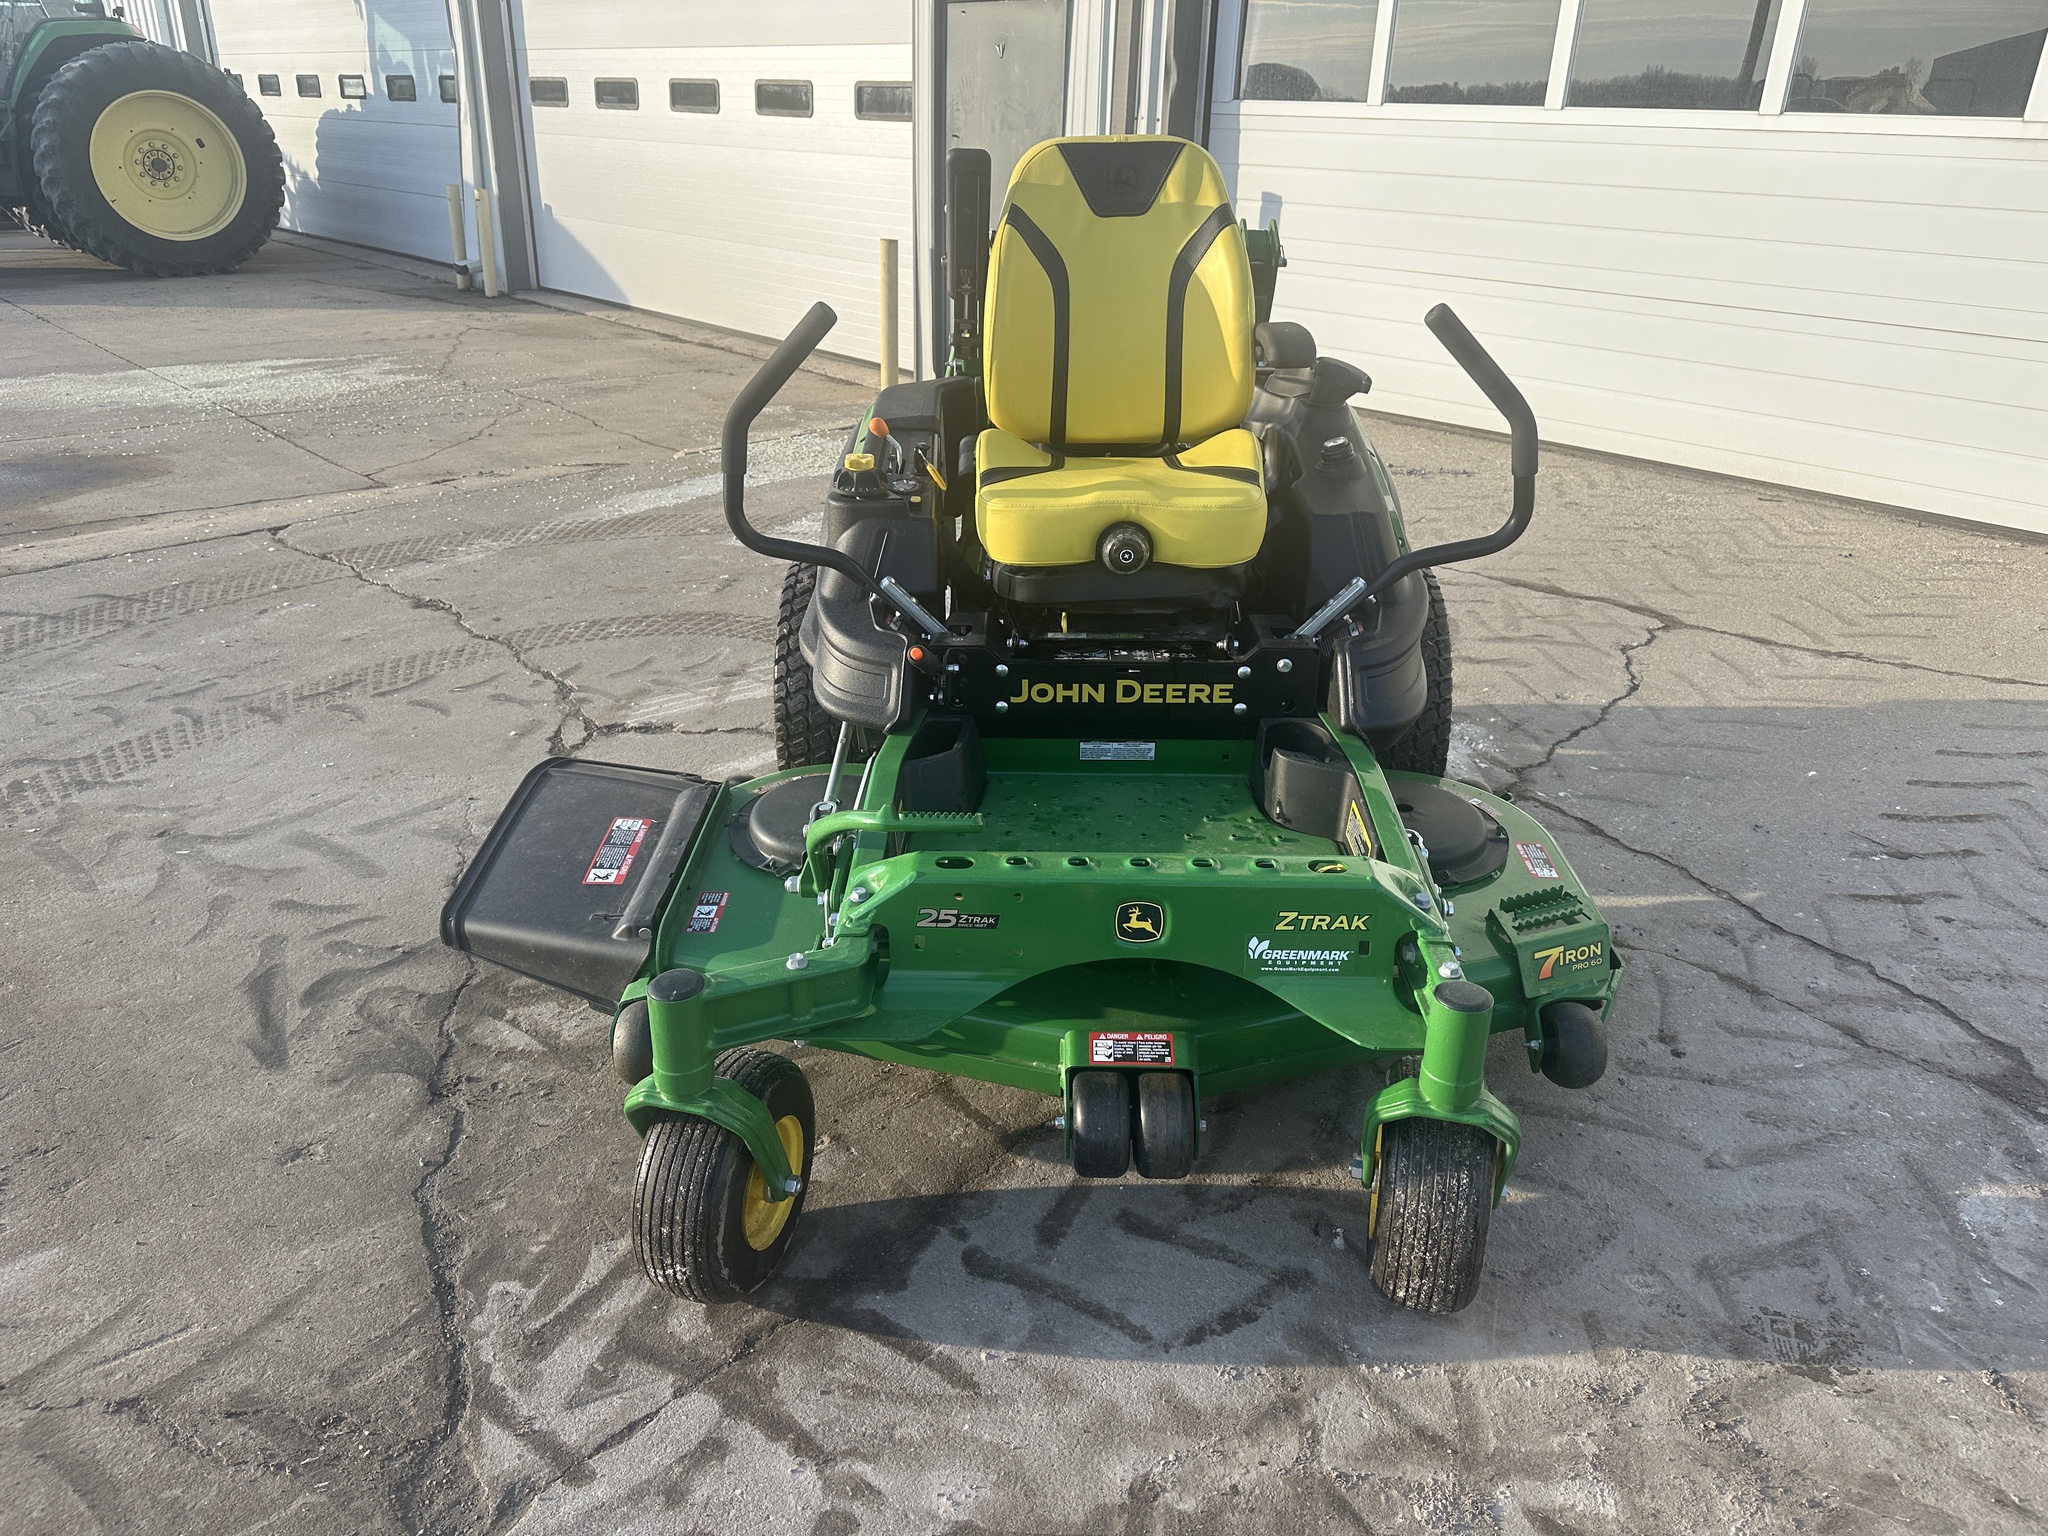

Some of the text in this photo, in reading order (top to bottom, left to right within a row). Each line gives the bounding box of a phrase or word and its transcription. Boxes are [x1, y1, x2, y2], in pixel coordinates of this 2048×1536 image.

[1010, 679, 1234, 704] JOHN DEERE
[916, 908, 996, 928] 25 ZTRAK
[1274, 911, 1371, 931] ZTRAK
[1262, 949, 1350, 961] GREENMARK
[1572, 957, 1603, 972] PRO 60
